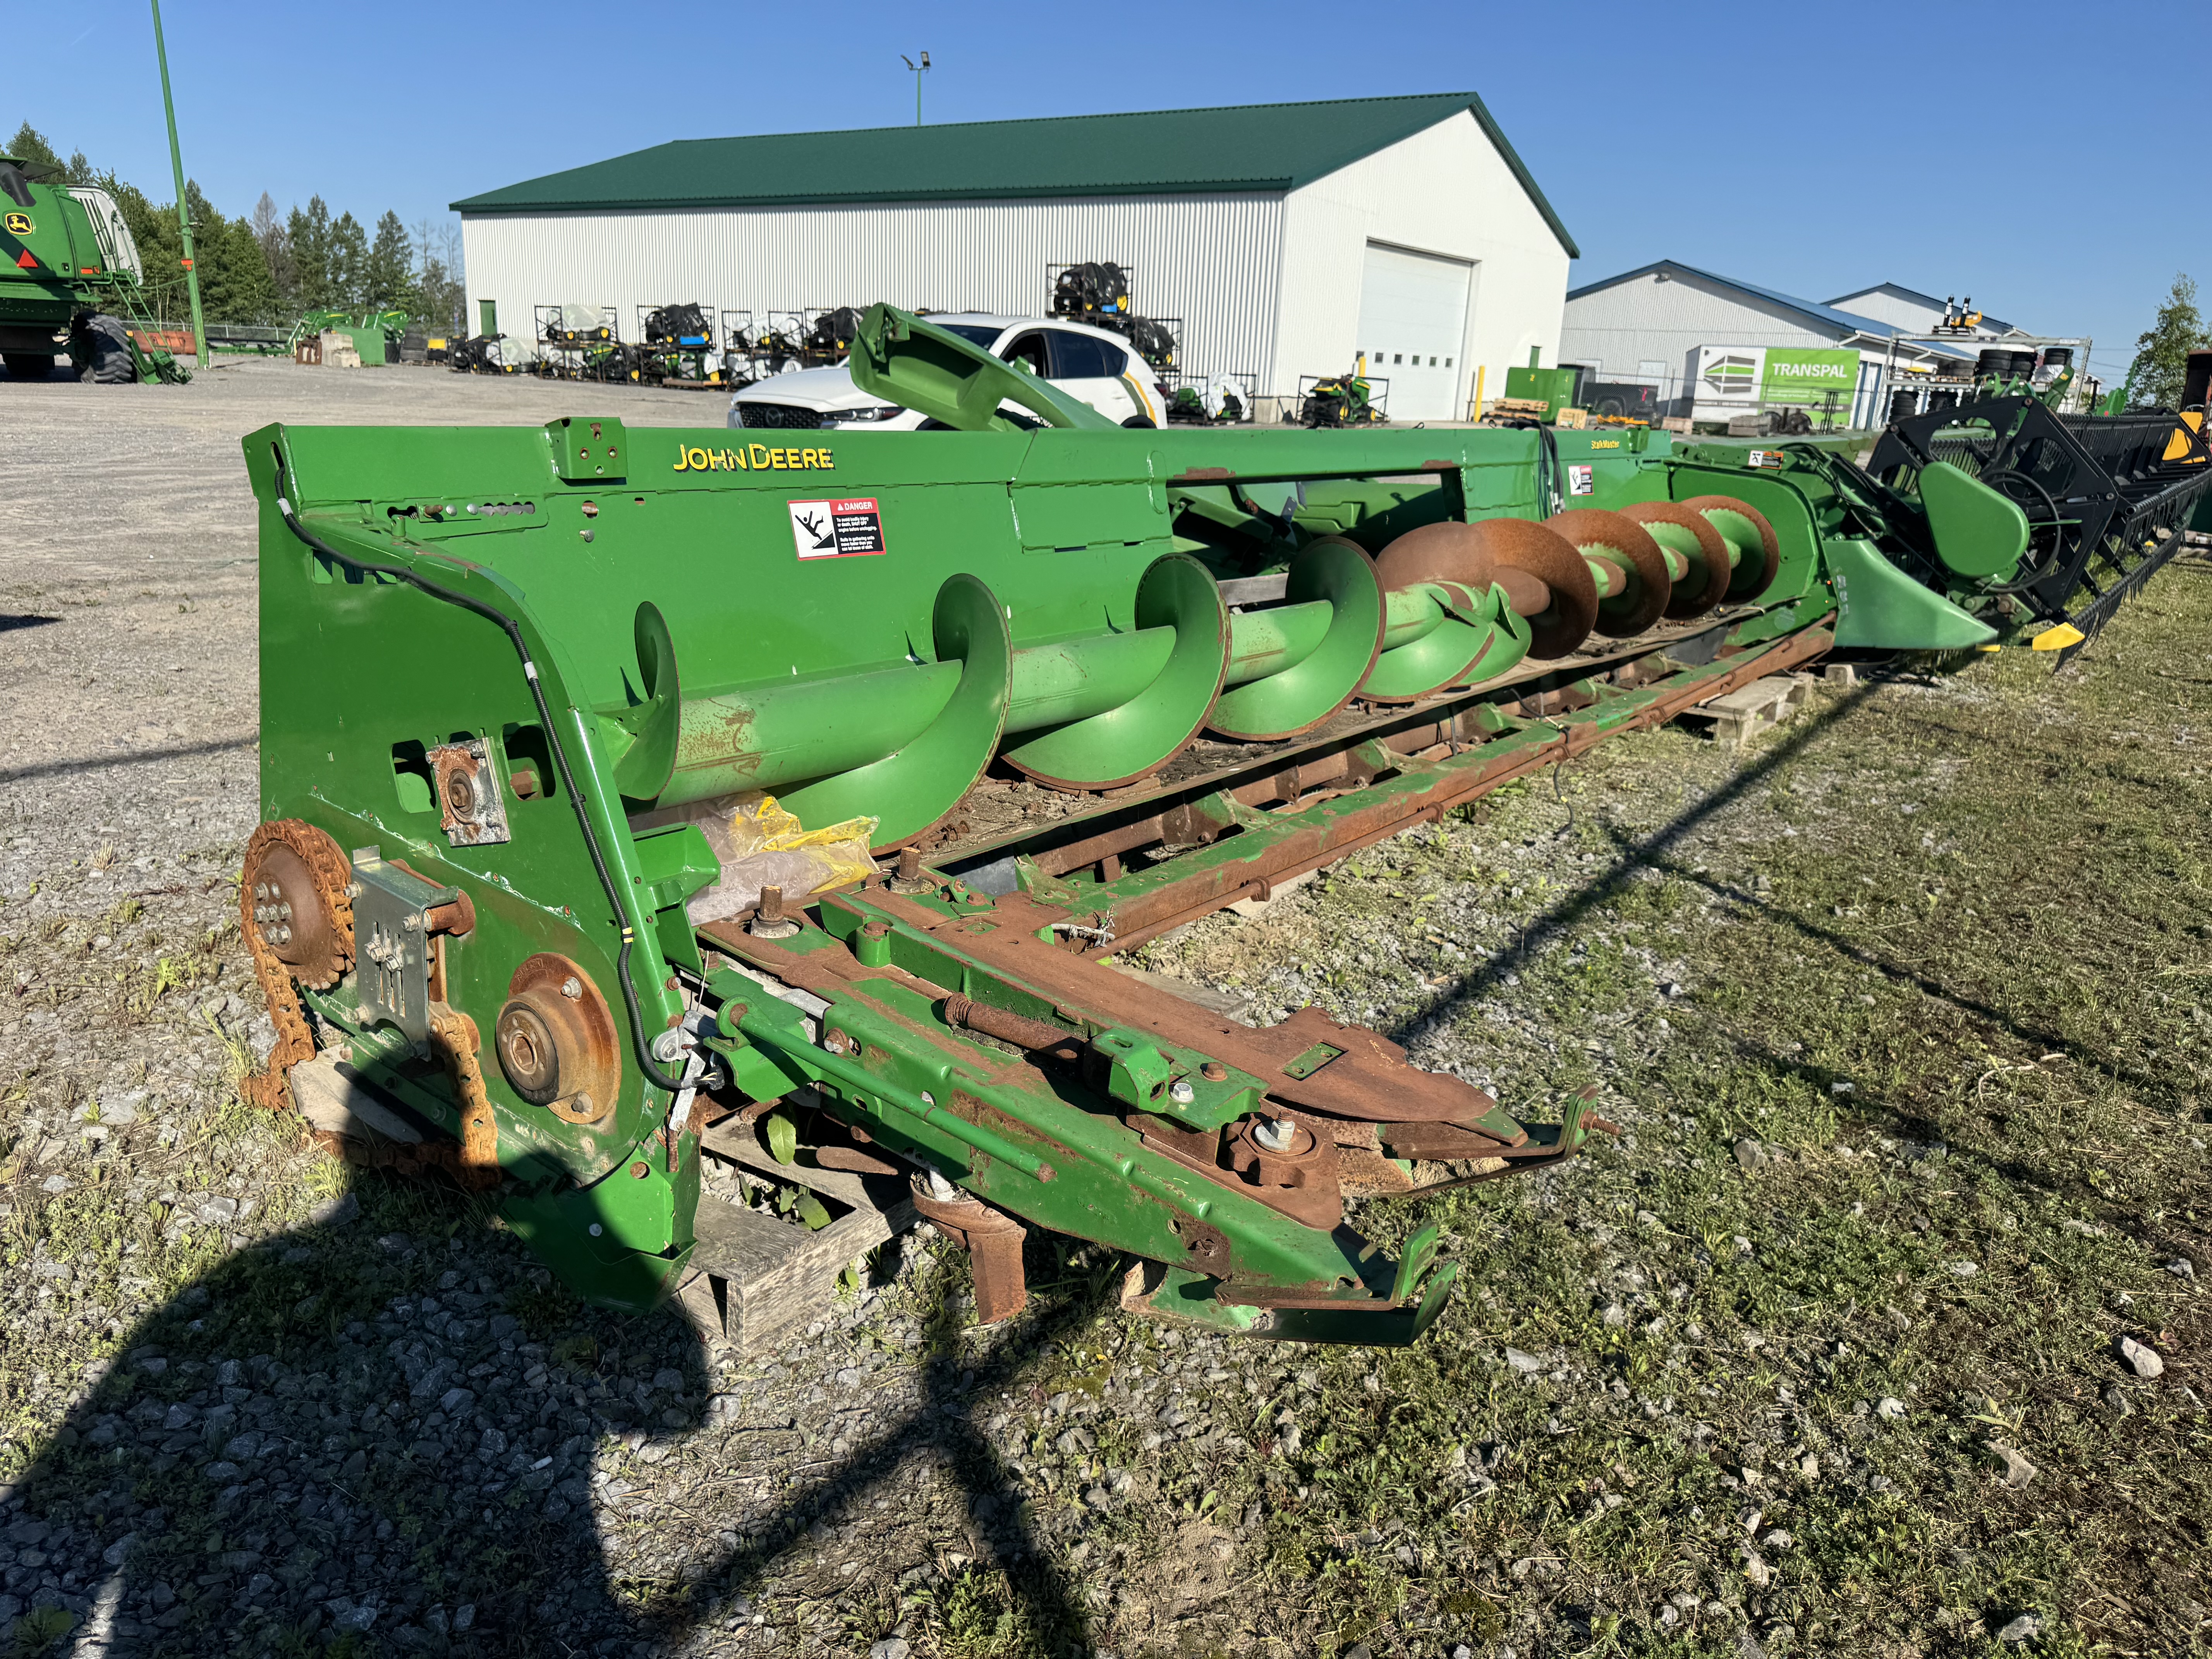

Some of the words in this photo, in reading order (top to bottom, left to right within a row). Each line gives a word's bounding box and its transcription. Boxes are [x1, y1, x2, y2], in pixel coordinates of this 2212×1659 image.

[1772, 363, 1848, 378] TRANSPAL
[673, 444, 747, 470] JOHN
[749, 443, 834, 469] DEERE
[844, 501, 872, 510] DANGER
